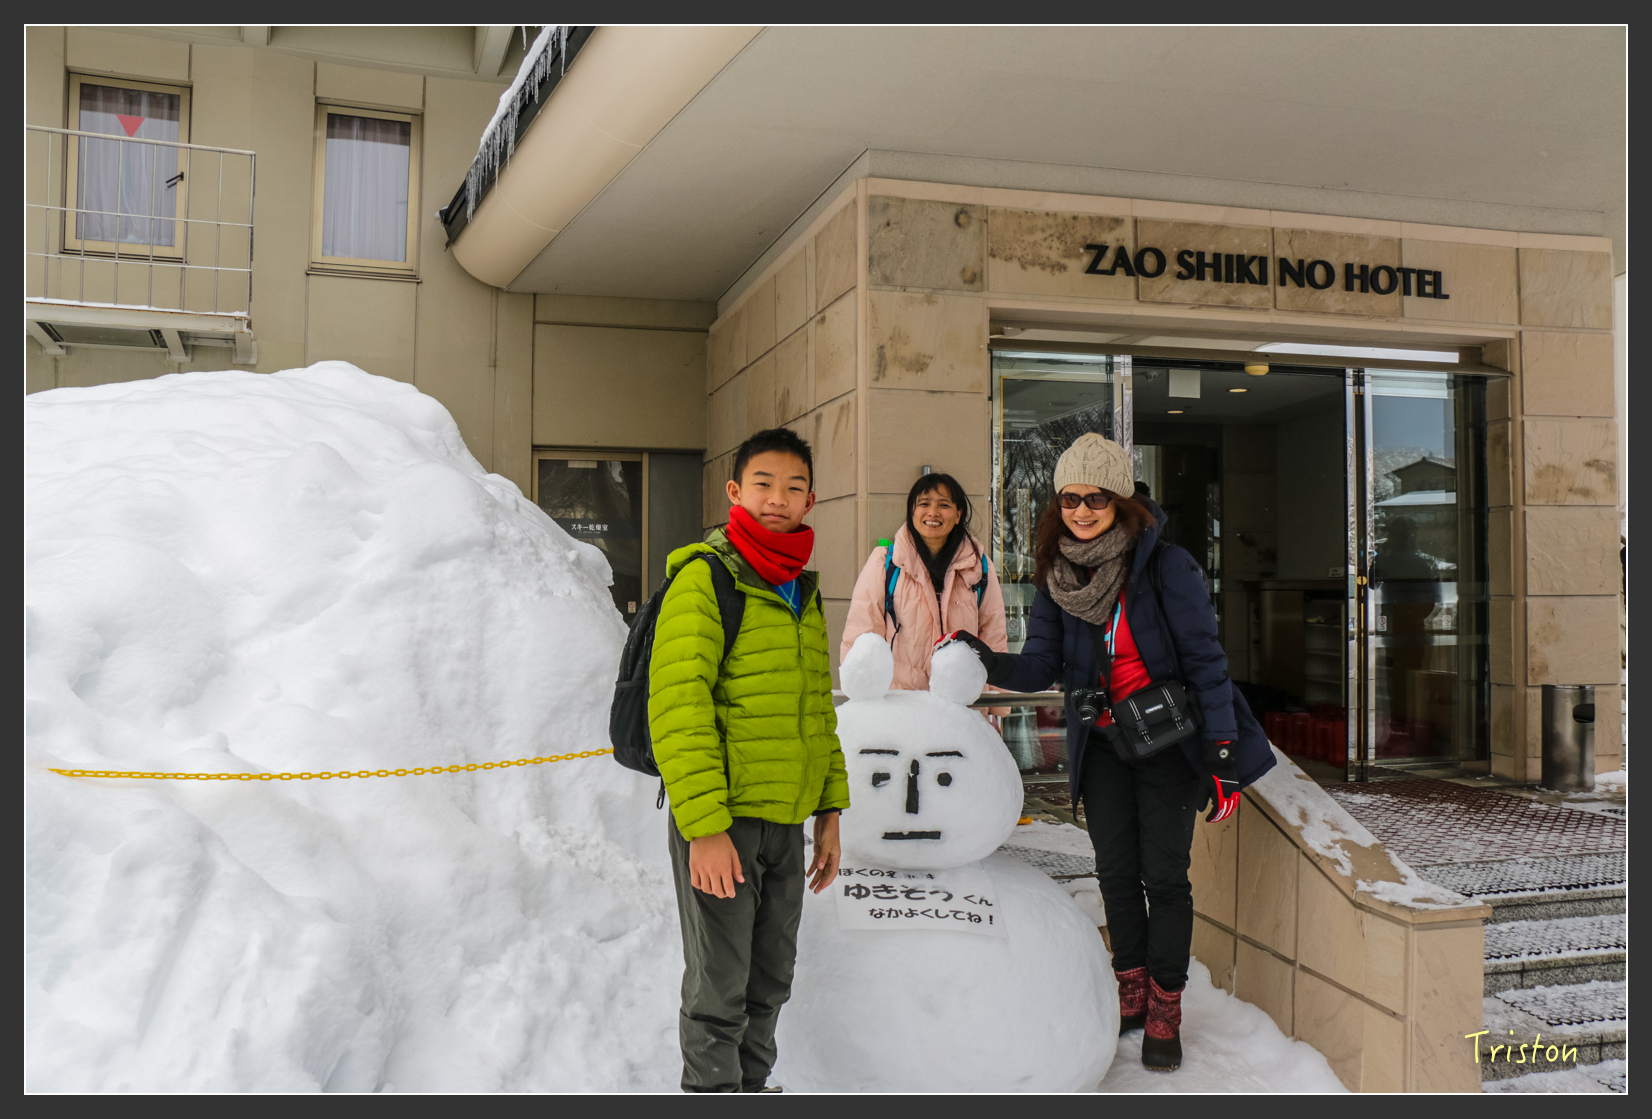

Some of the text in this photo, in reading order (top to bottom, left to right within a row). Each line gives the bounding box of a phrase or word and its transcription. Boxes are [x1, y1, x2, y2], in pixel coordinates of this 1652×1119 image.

[1085, 244, 1450, 300] ZAO SHIKI NO HOTEL
